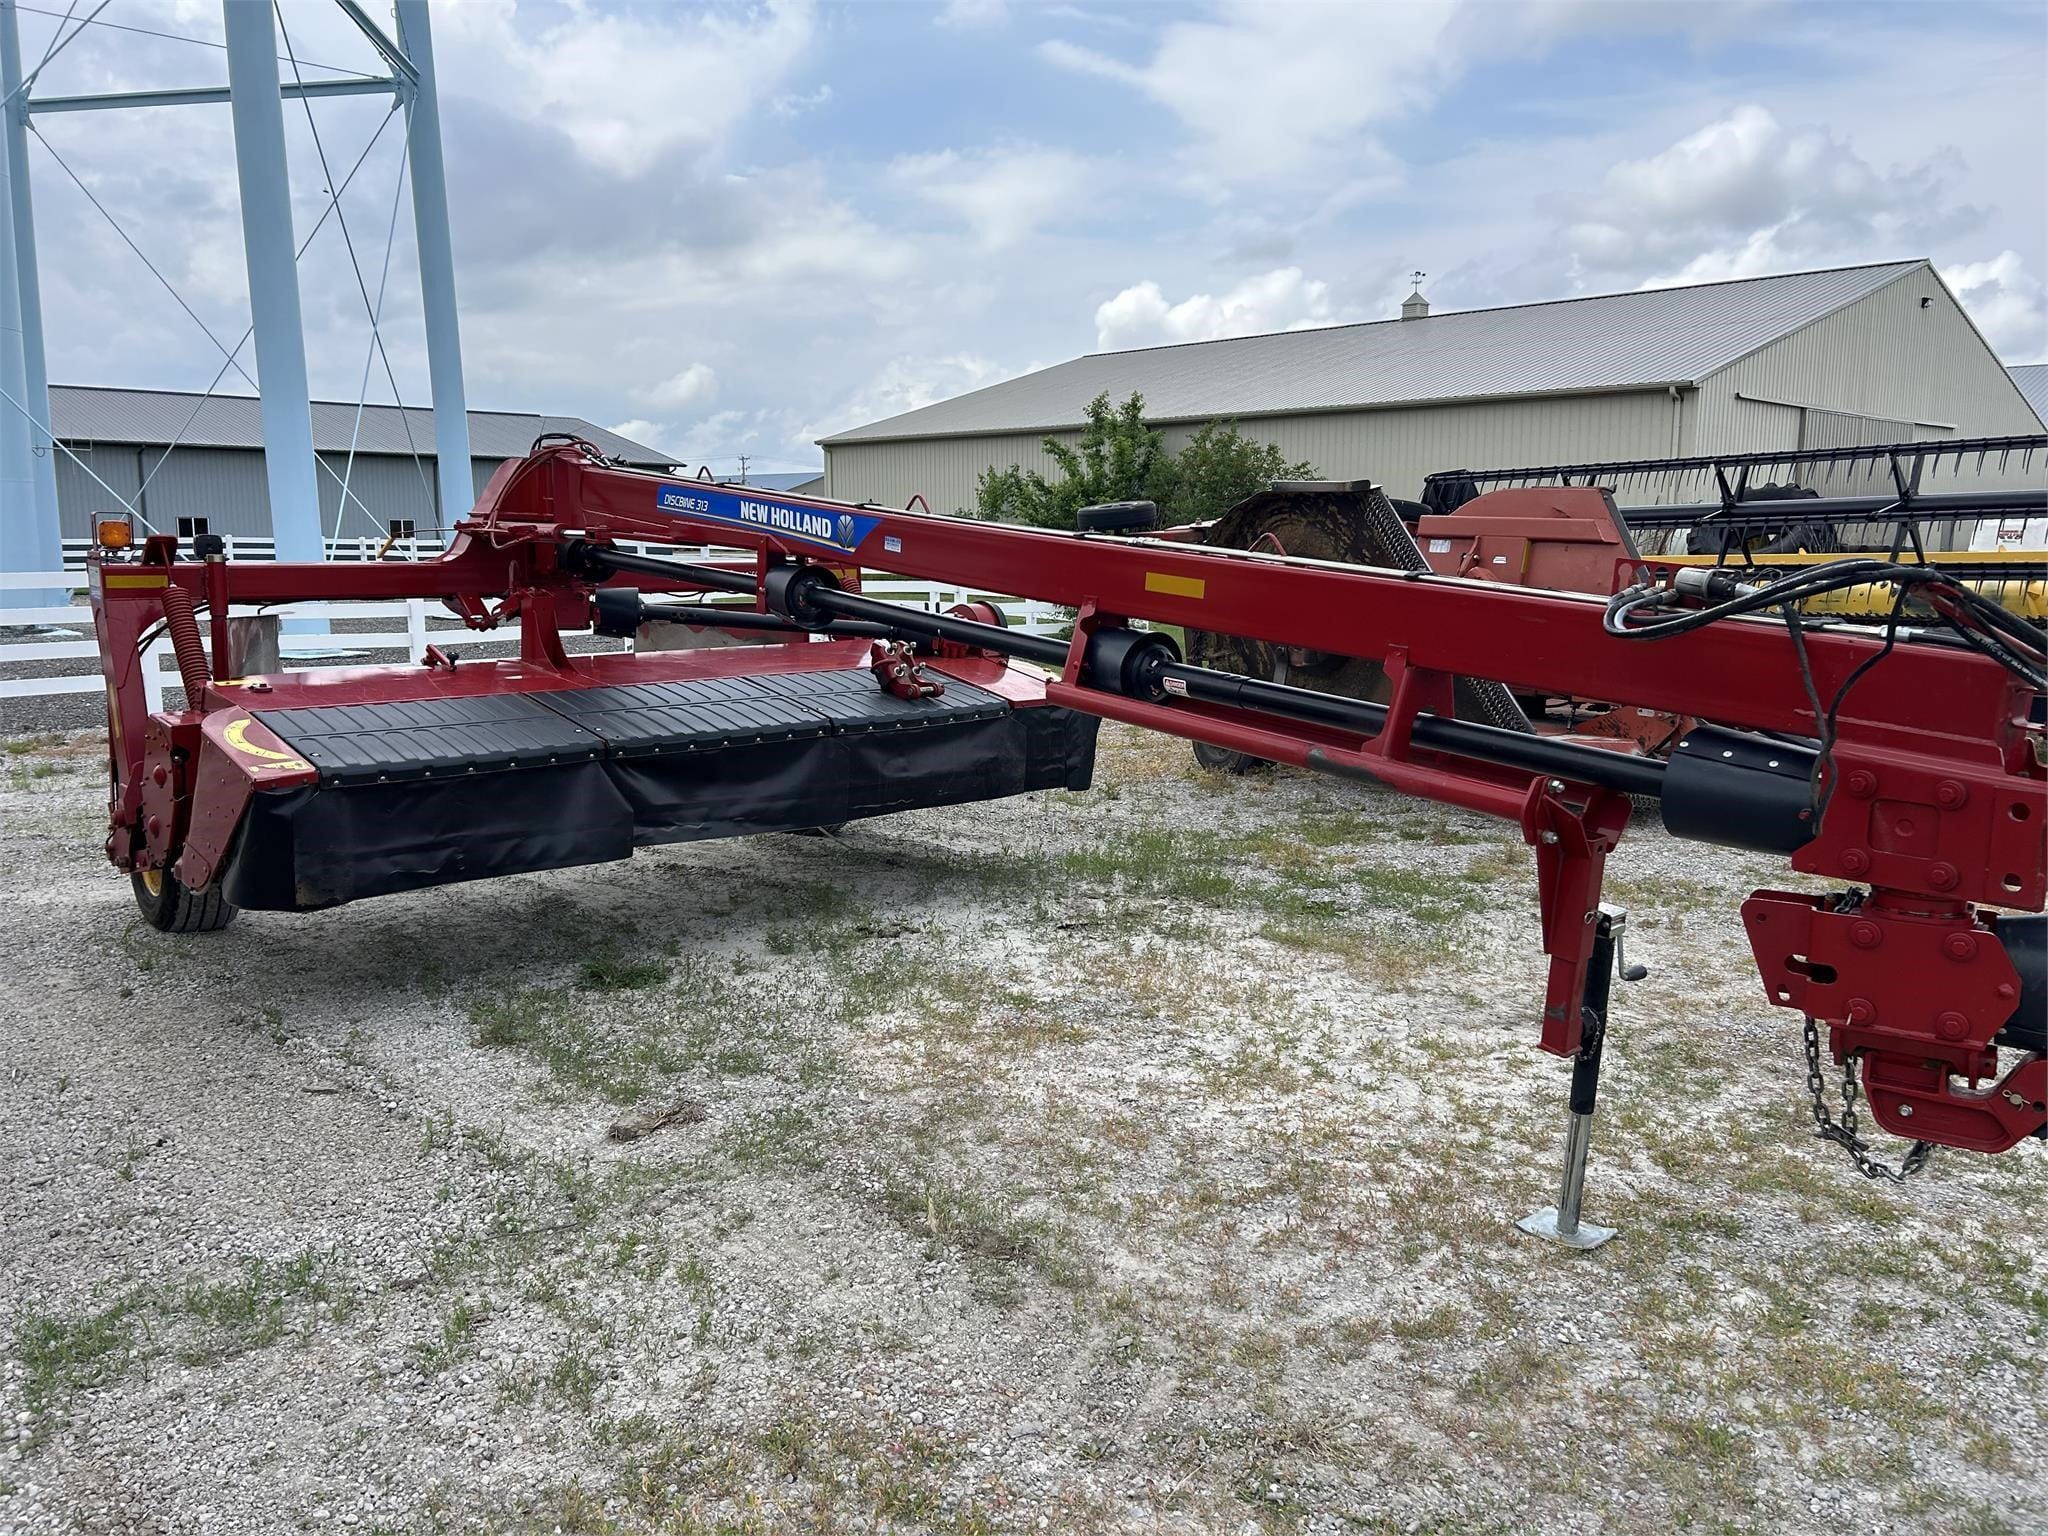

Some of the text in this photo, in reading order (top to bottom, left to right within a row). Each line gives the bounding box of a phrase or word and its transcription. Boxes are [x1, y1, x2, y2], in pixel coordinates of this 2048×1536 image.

[695, 499, 709, 512] 313
[740, 501, 832, 538] NEW HOLLAND
